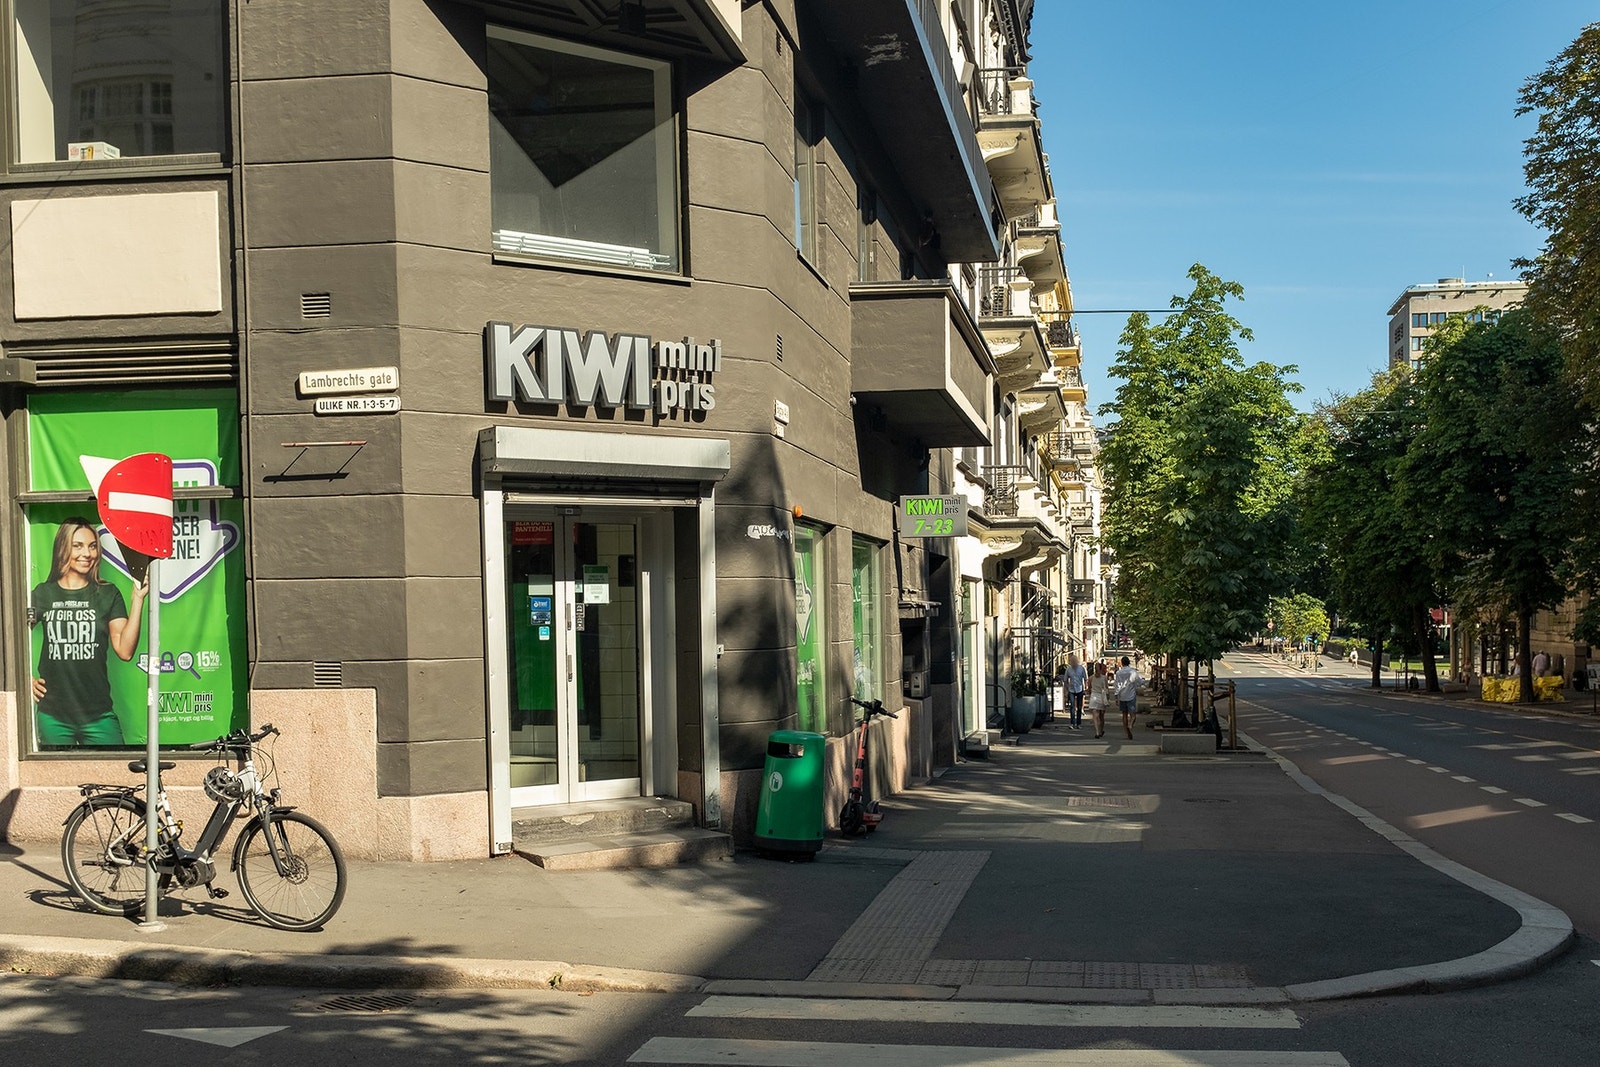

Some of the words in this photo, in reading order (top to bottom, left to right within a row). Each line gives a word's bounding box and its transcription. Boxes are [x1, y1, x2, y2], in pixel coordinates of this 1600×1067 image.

[656, 337, 721, 372] mini
[488, 322, 652, 409] KIWI
[305, 373, 365, 388] Lambrechts
[370, 372, 392, 388] gate
[657, 376, 716, 415] pris
[319, 400, 343, 410] ULIKE
[346, 400, 361, 410] NR.
[363, 399, 395, 409] 1-3-5-7
[906, 498, 943, 515] KIWI
[944, 497, 961, 505] mini
[944, 506, 959, 515] pris
[172, 516, 199, 536] SER
[56, 609, 73, 621] GIR
[75, 609, 96, 621] OSS
[47, 621, 96, 643] ALDRI
[48, 640, 61, 660] PÅ
[196, 651, 220, 667] 15%
[194, 691, 213, 702] mini
[194, 702, 212, 713] pris
